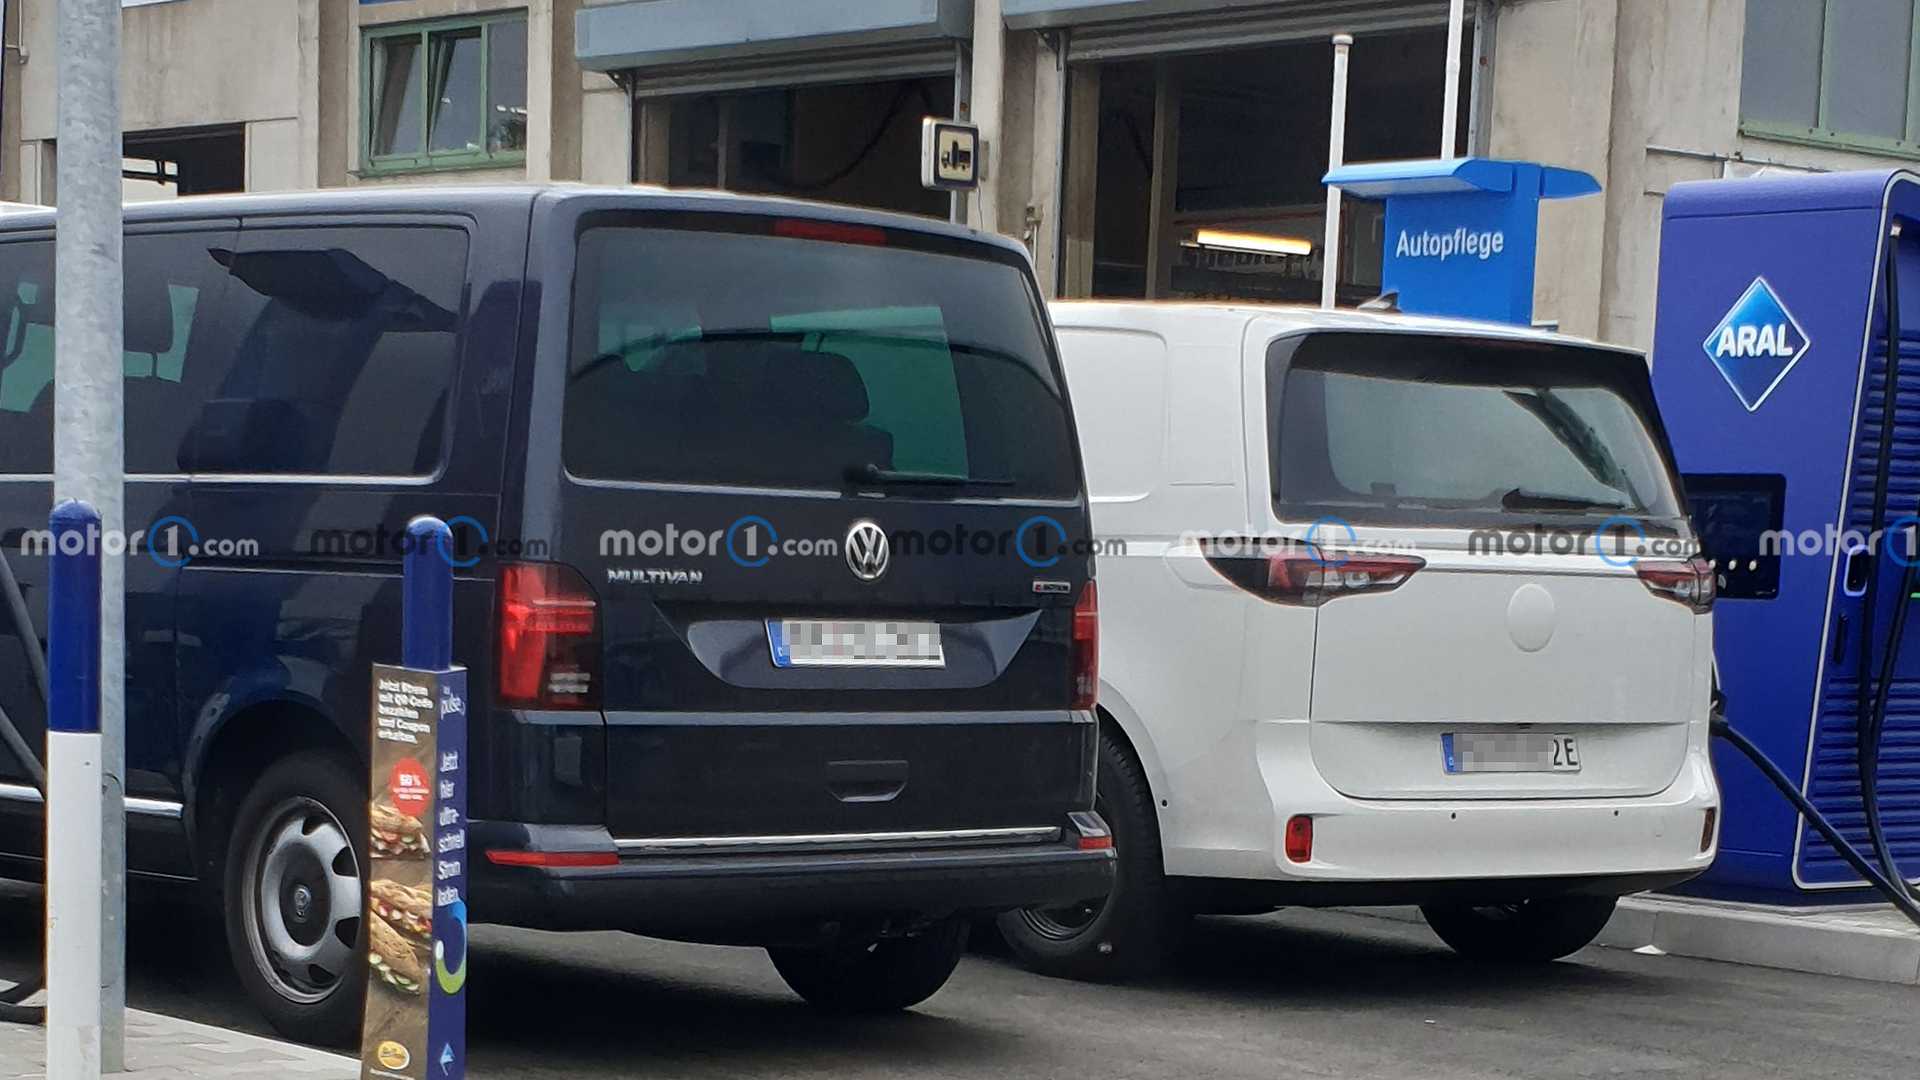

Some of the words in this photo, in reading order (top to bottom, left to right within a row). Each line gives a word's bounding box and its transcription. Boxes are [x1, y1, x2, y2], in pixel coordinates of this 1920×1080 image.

[1396, 227, 1504, 261] Autopflege
[1716, 323, 1793, 358] ARAL
[607, 568, 703, 584] MULTIVAN
